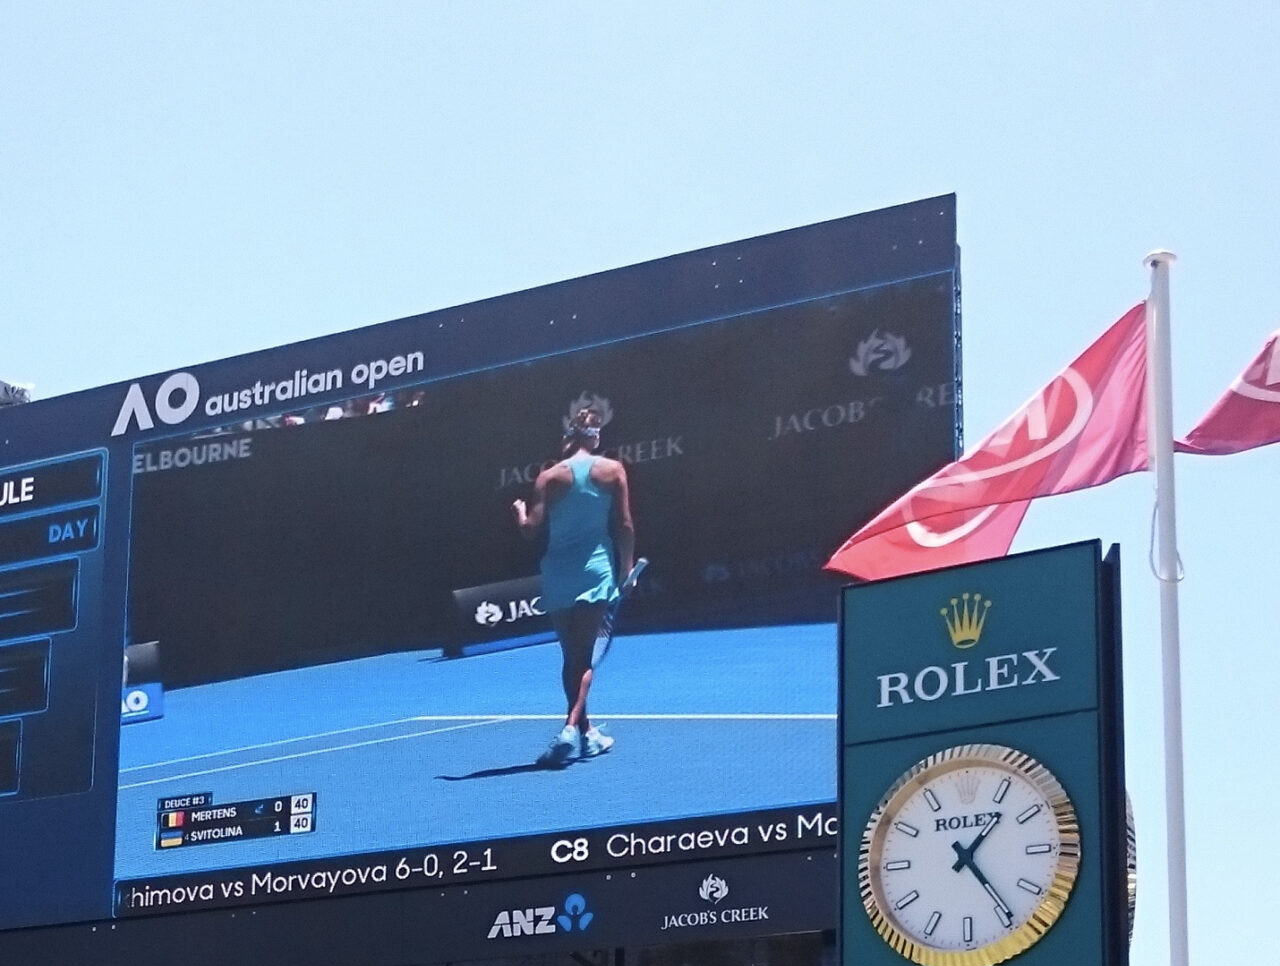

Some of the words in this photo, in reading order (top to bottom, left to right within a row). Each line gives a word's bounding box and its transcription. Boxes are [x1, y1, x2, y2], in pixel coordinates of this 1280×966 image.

[111, 371, 200, 437] AO
[205, 368, 343, 417] australian
[351, 351, 425, 391] open
[133, 438, 252, 474] ELBOURNE
[48, 519, 89, 544] DAY
[876, 647, 1061, 708] ROLEX
[165, 798, 191, 809] DEUCE
[191, 807, 237, 822] MERTENS
[274, 801, 283, 812] 0
[294, 798, 309, 809] 40
[190, 825, 243, 842] SVITOLINA
[274, 821, 282, 832] 1
[294, 817, 309, 829] 40
[934, 811, 1004, 832] ROLEX
[127, 884, 215, 908] himova
[221, 878, 244, 899] vs
[251, 863, 388, 896] Morvayova
[395, 853, 444, 880] 6-0,
[453, 848, 497, 874] 2-1
[550, 837, 590, 863] C8
[606, 824, 748, 858] Charaeva
[757, 821, 787, 843] vs
[486, 905, 557, 939] ANZ
[660, 909, 718, 930] JACOB'S
[720, 906, 770, 924] CREEK
